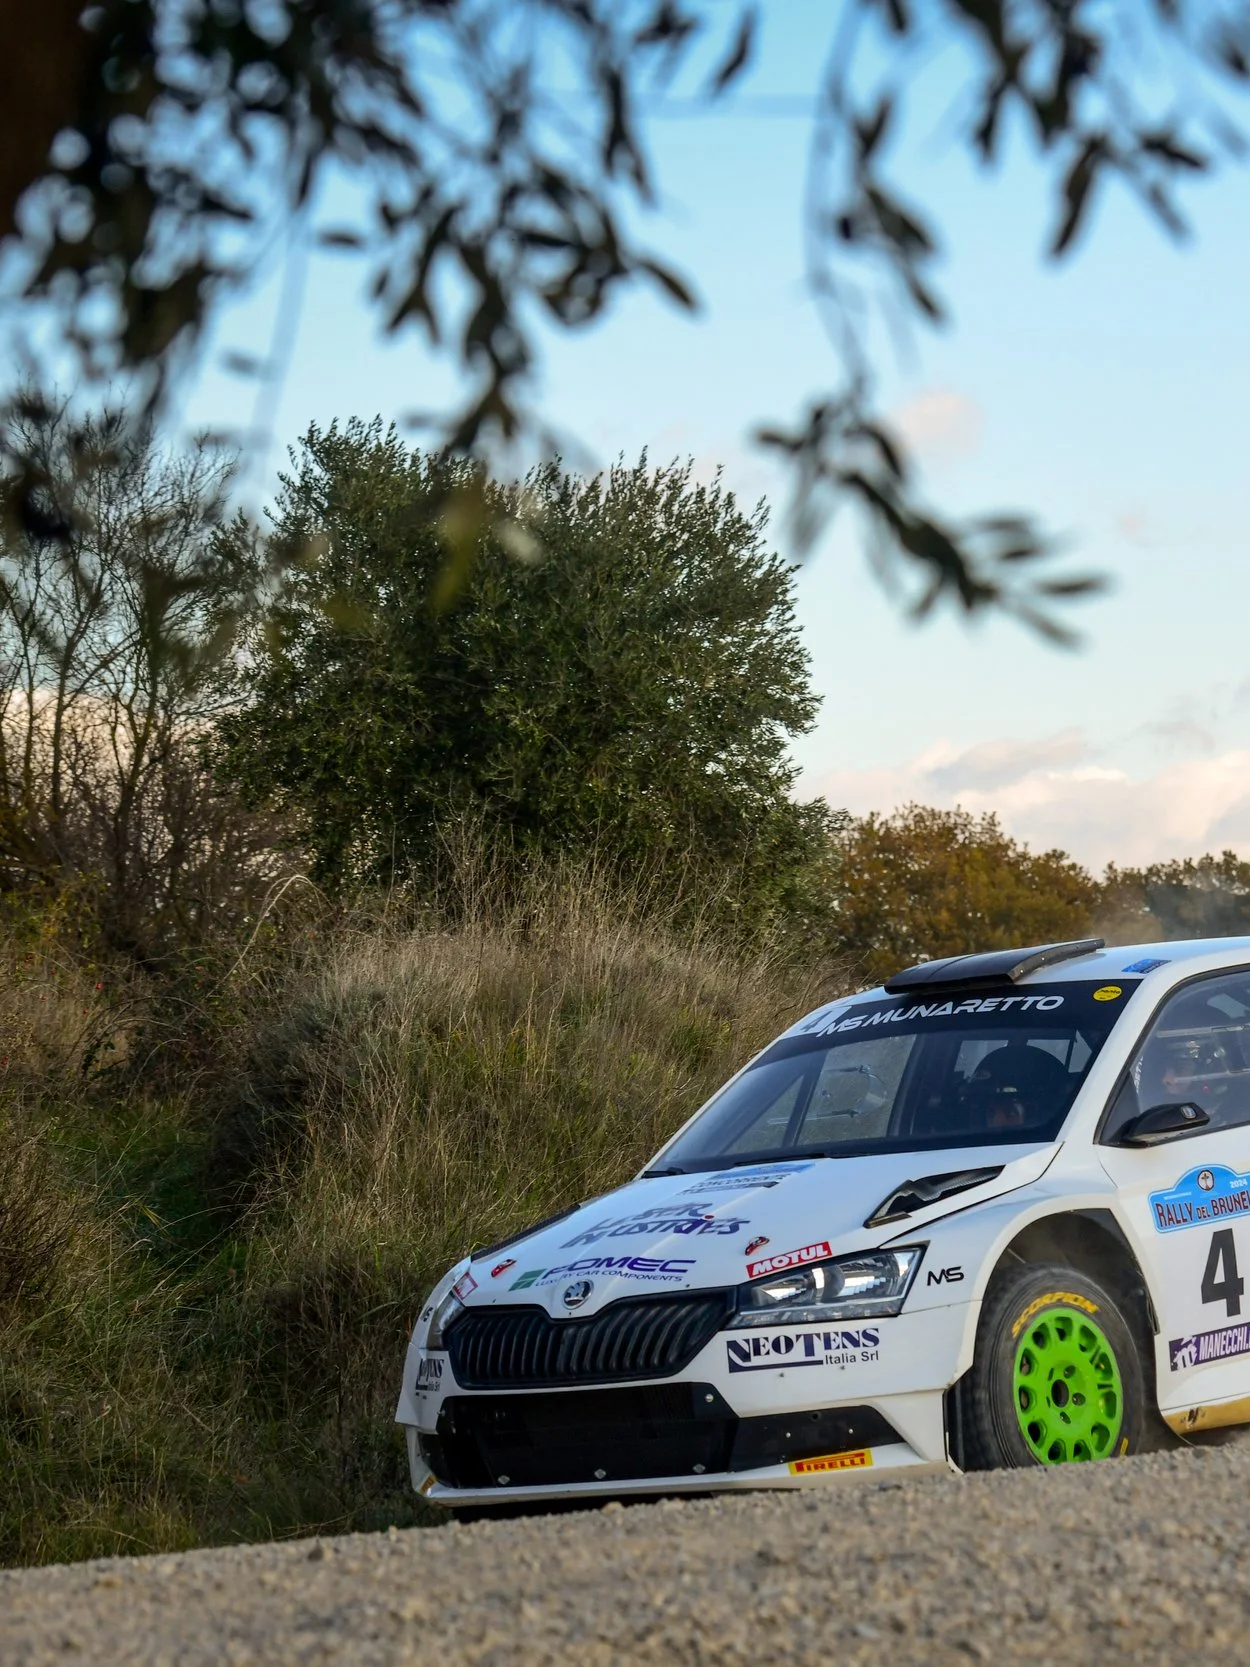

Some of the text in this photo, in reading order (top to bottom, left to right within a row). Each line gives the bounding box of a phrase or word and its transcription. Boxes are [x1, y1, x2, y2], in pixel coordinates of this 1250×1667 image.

[861, 995, 1064, 1028] MUNARETTO
[1229, 1178, 1249, 1189] 2024
[1155, 1202, 1193, 1227] RALLY
[1196, 1206, 1211, 1219] DEL
[751, 1244, 829, 1275] MOTUL
[602, 1270, 684, 1283] COMPONENTS
[927, 1266, 965, 1286] MS
[1201, 1228, 1244, 1317] 4
[726, 1328, 880, 1367] NEOTENS
[825, 1350, 880, 1365] Italia Srl
[795, 1452, 866, 1473] PIRELLI
